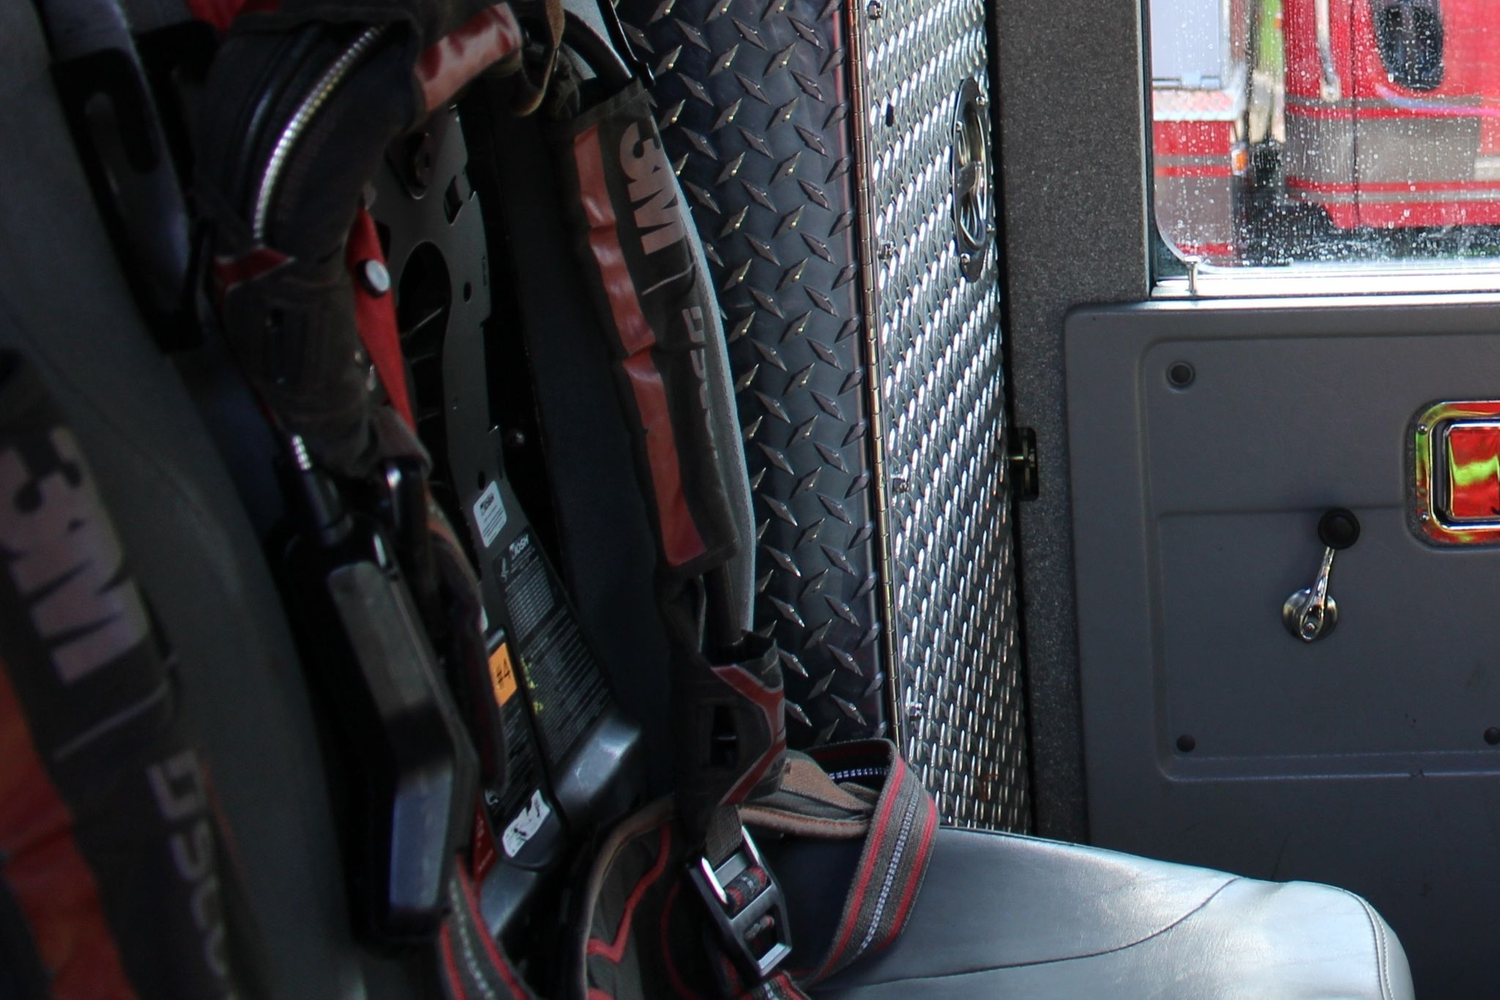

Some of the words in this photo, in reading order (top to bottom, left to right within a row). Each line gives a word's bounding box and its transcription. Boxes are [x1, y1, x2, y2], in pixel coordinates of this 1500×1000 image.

[619, 116, 685, 256] 3M
[0, 427, 150, 688] 3M
[495, 658, 512, 689] #4
